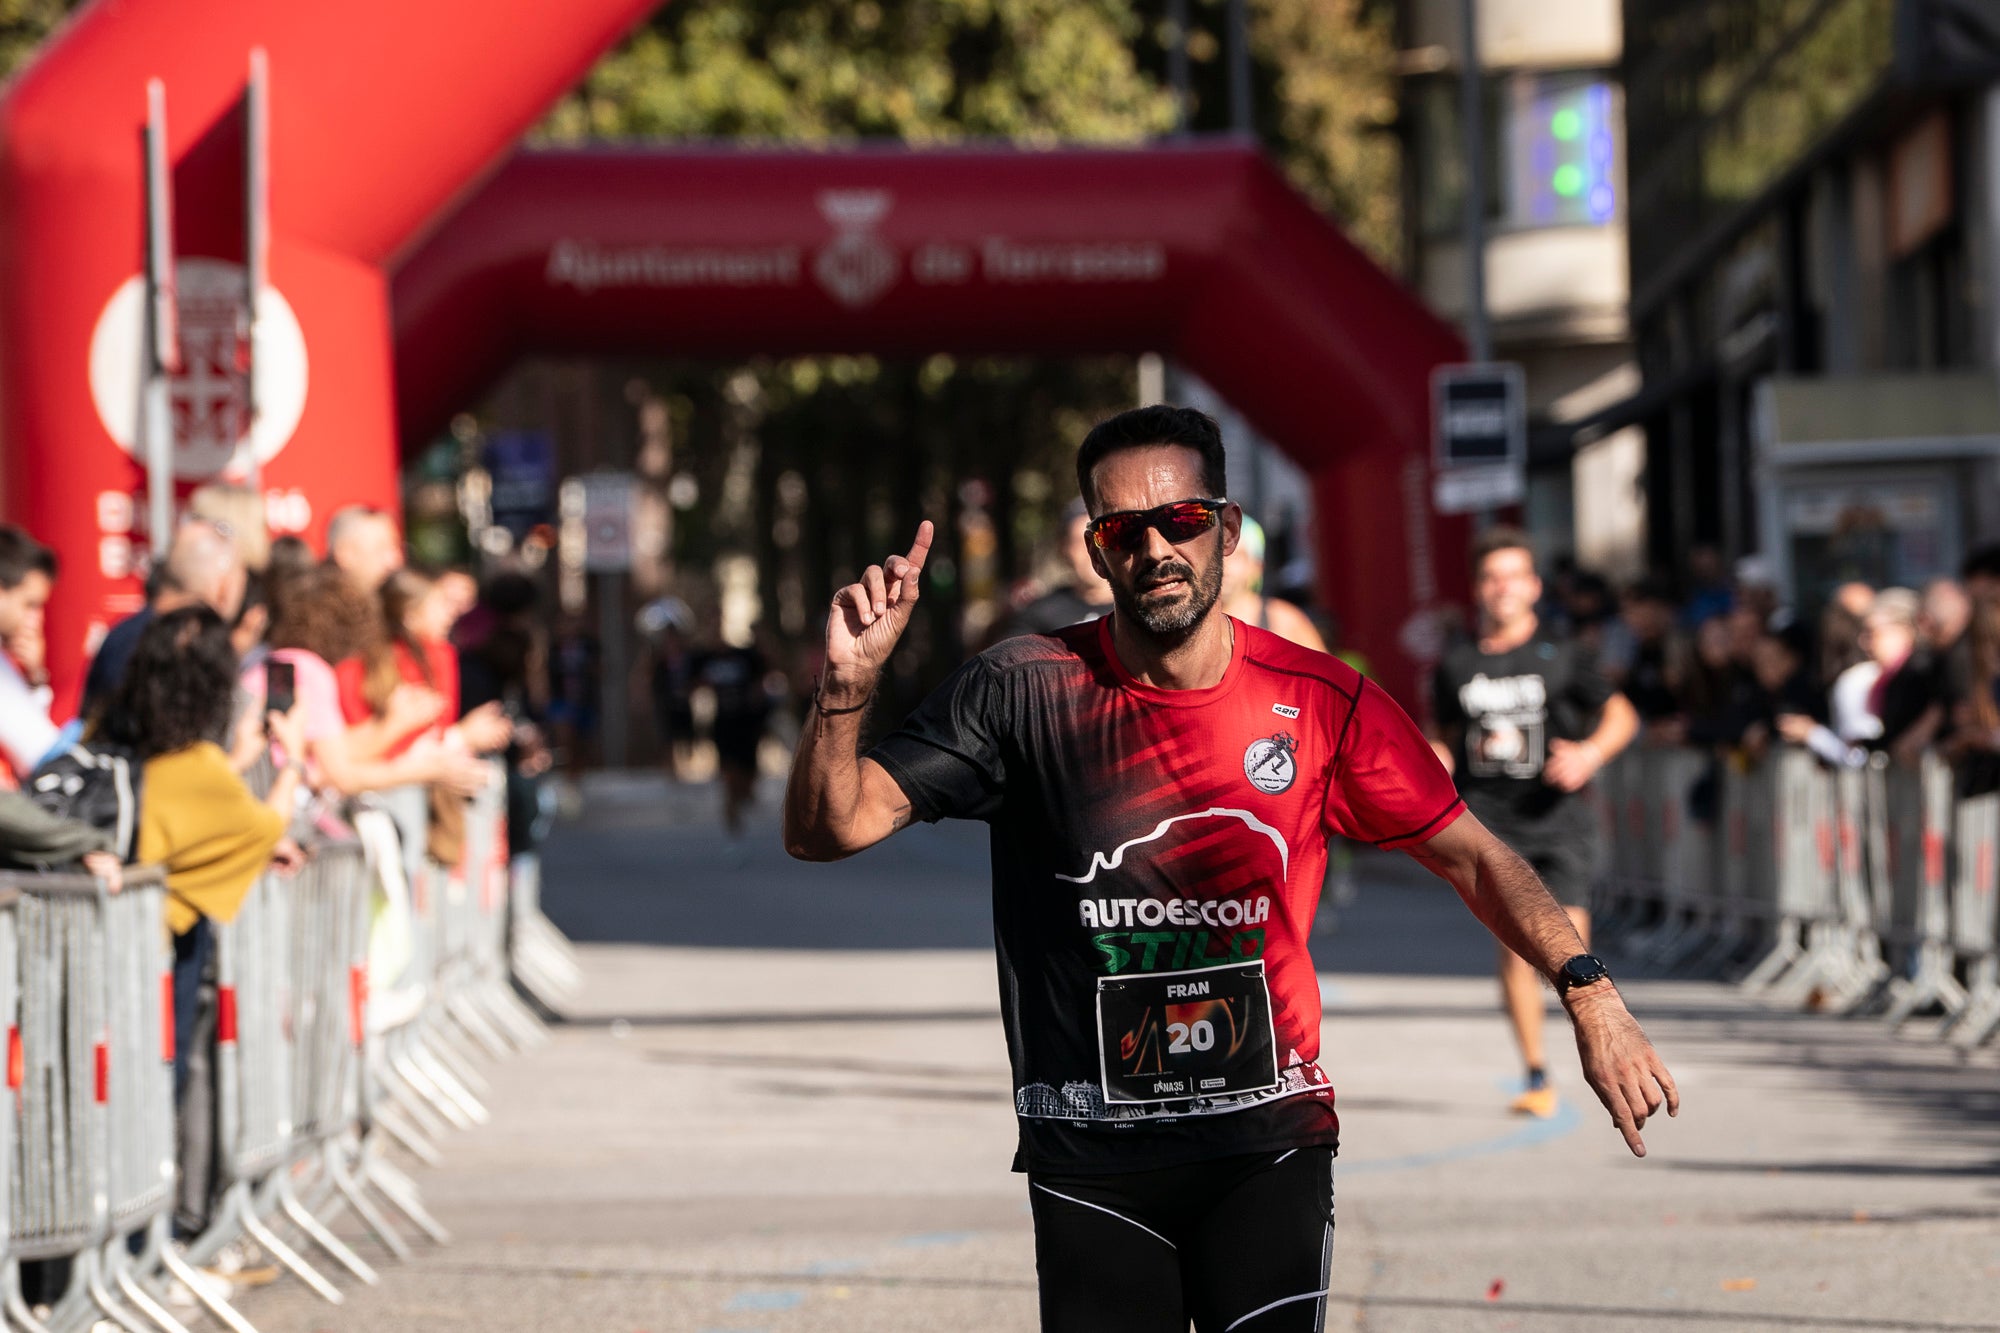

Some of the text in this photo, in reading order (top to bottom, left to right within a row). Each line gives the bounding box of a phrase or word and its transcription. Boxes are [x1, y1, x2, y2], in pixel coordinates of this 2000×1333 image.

[547, 236, 1167, 289] Ajuntament de Terrassa
[1079, 896, 1270, 928] AUTOESCOLA
[1092, 928, 1266, 974] STILO
[1166, 981, 1210, 998] FRAN
[1166, 1020, 1215, 1054] 20
